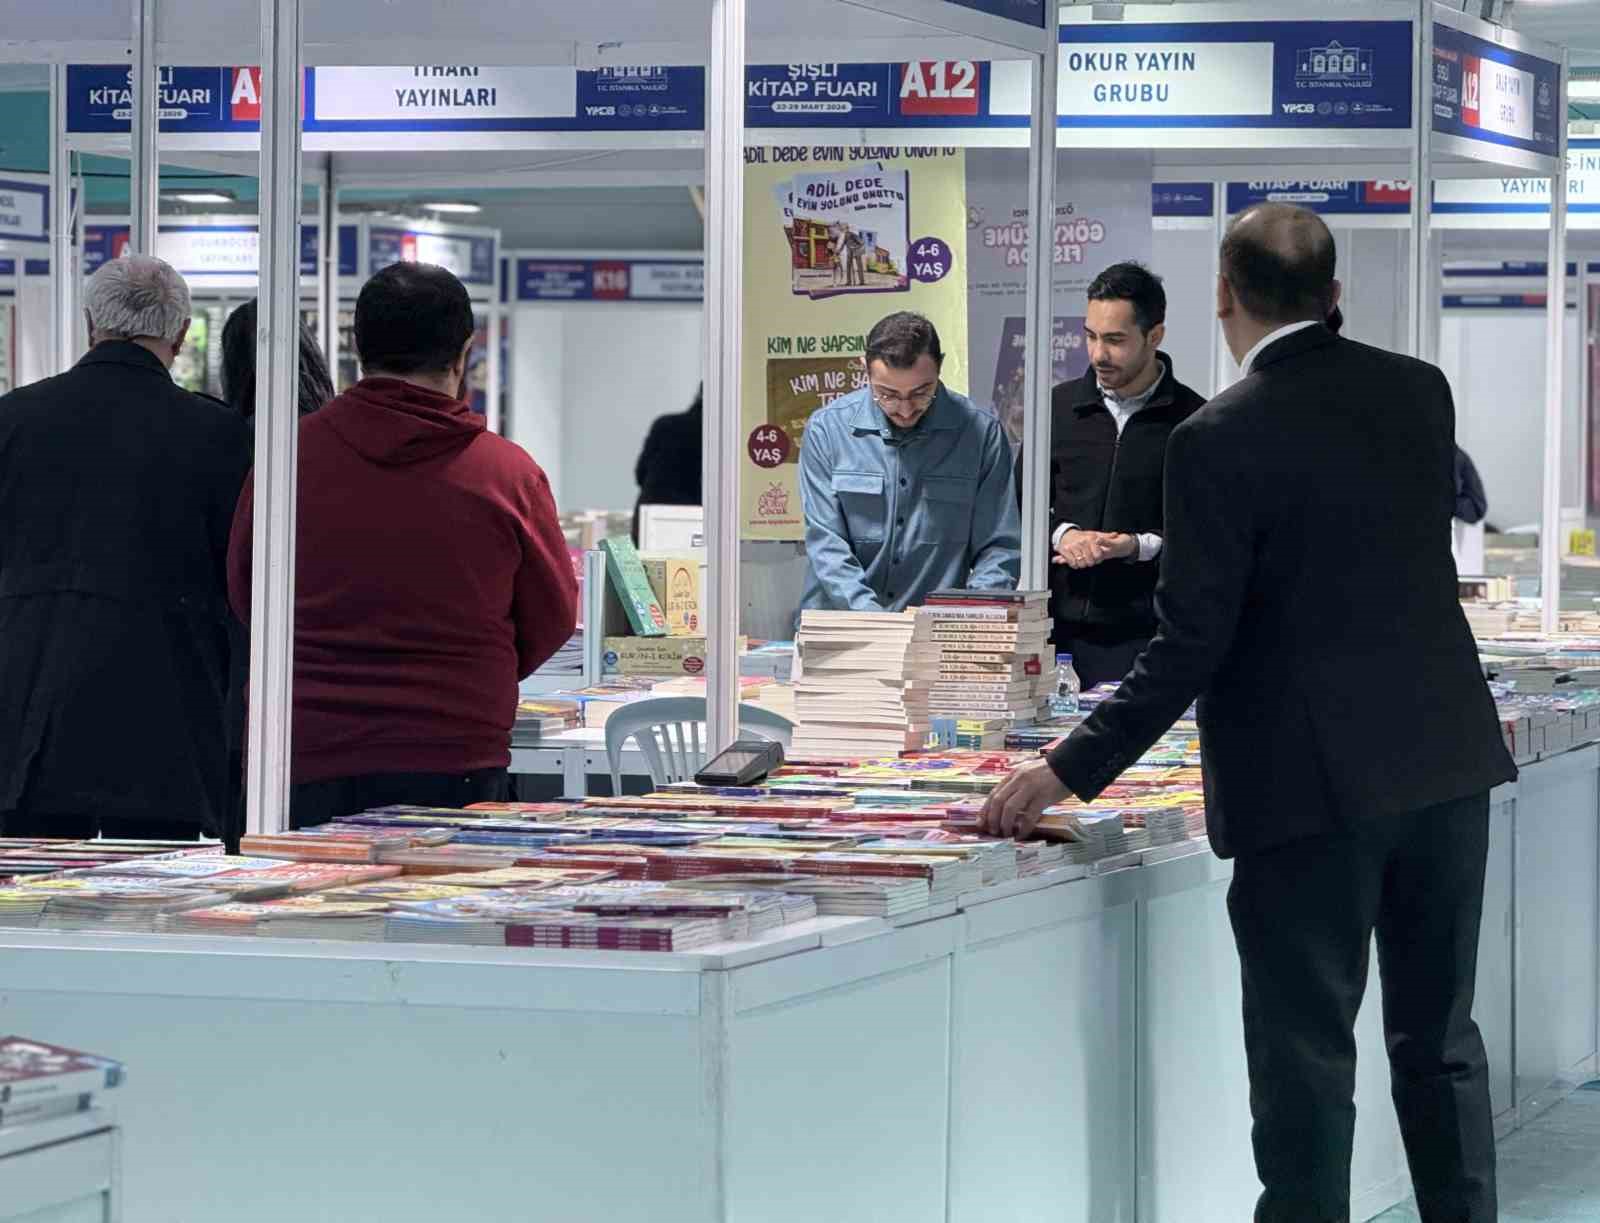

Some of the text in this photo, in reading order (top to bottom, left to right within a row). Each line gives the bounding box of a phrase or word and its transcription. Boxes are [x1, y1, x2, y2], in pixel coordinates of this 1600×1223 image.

[1069, 53, 1196, 71] OKUR YAYIN
[748, 78, 878, 97] KİTAP FUARI
[899, 61, 976, 98] A12
[89, 86, 132, 105] KİTA
[396, 88, 496, 107] YAYINLARI
[1094, 84, 1169, 102] GRUBU
[1461, 71, 1479, 111] A12
[806, 178, 883, 198] ADİL DEDE
[916, 244, 940, 256] 4-6
[914, 263, 944, 278] YAŞ
[755, 430, 778, 442] 4-6
[753, 447, 782, 462] YAŞ
